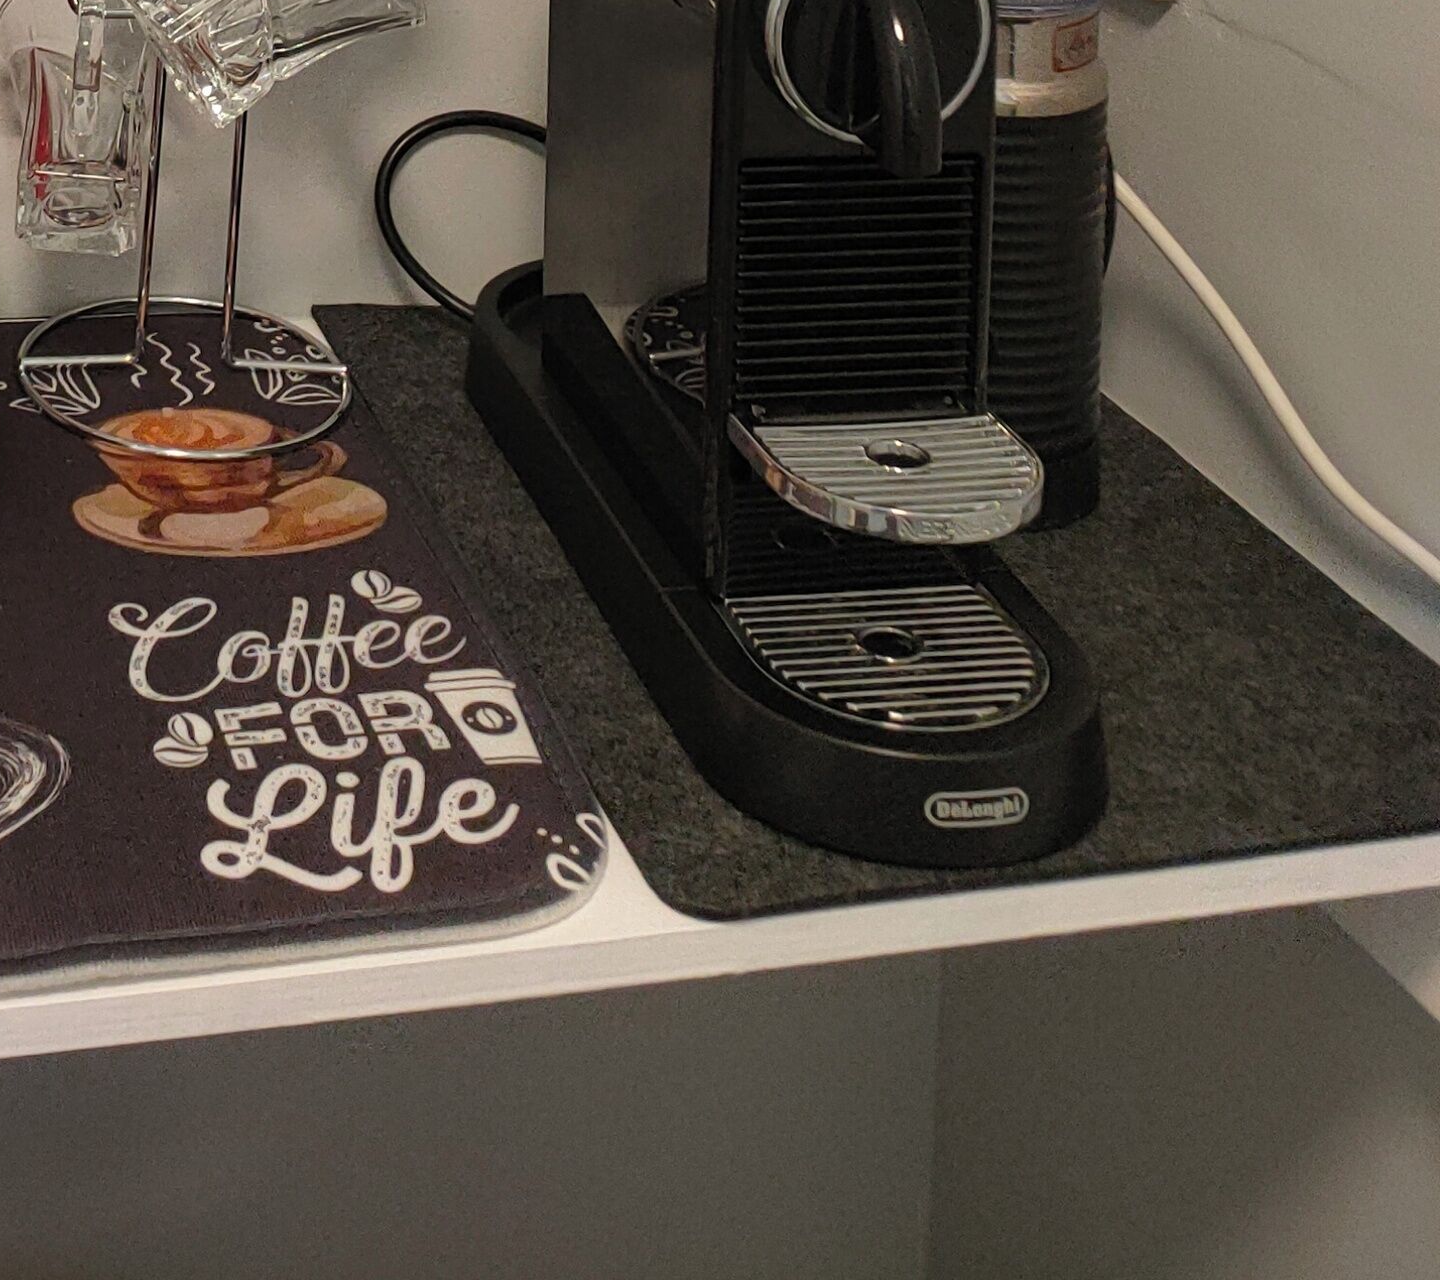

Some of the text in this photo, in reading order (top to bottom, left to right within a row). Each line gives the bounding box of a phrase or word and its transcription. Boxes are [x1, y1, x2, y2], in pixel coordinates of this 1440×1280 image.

[108, 594, 466, 702] Coffee
[215, 689, 451, 770] FOR
[200, 755, 520, 893] Life
